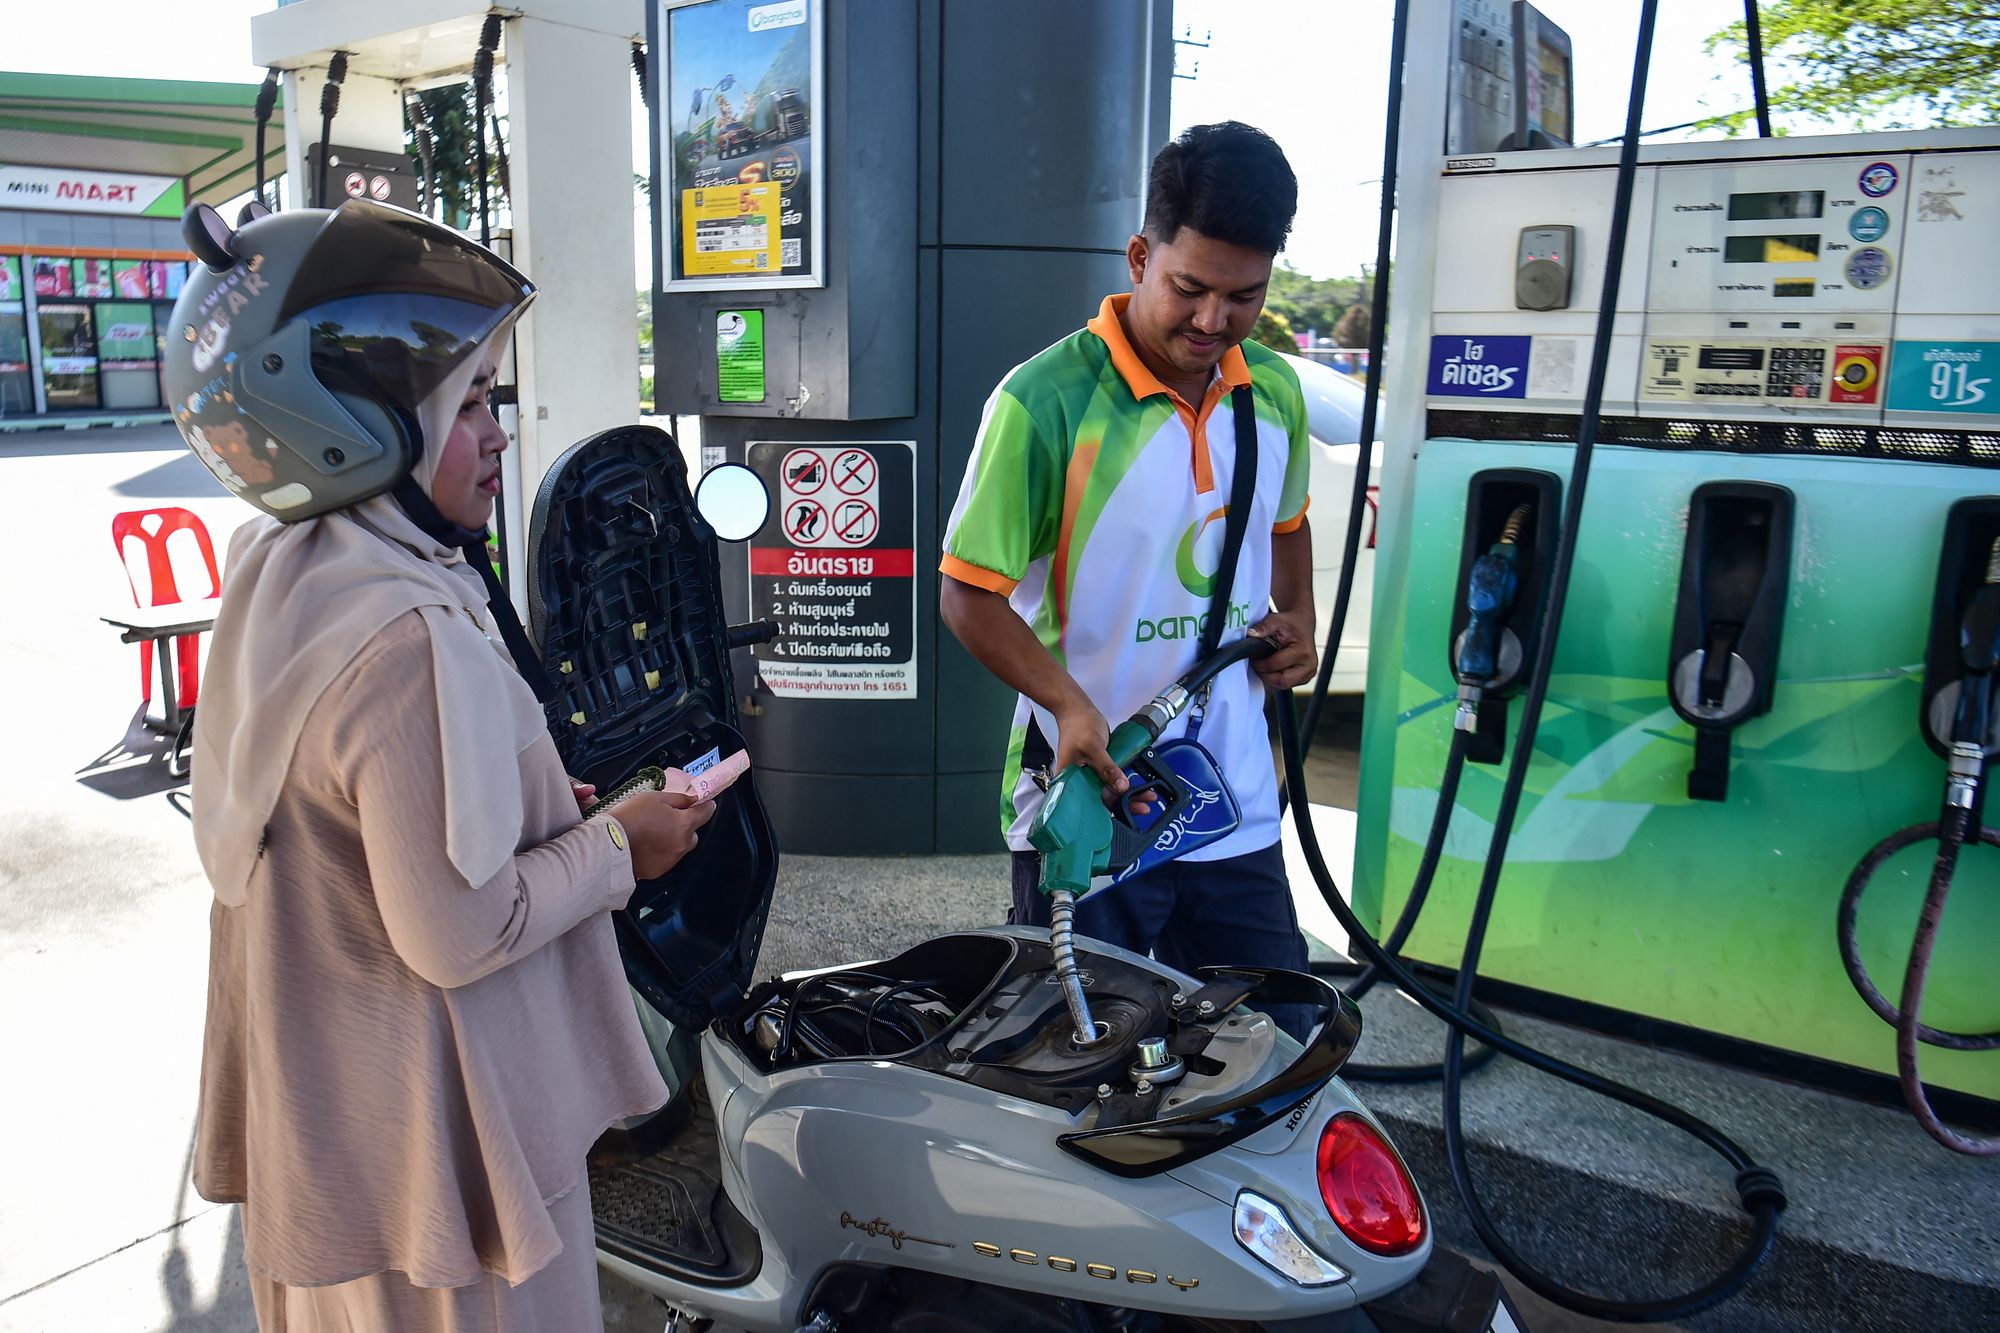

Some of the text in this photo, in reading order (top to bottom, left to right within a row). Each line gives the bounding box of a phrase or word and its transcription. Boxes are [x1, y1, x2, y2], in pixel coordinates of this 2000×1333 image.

[8, 180, 137, 203] MINI MART
[1463, 339, 1485, 361] ไฮ
[788, 551, 873, 575] อันตราย
[773, 578, 872, 596] 1. ดับเครื่องยนต์
[773, 599, 855, 620] 2. ห้ามสูบบุหรี่
[789, 622, 889, 637] ห้ามก่อประกายไฟ
[774, 642, 892, 657] 4. ปิดโทรศัพท์มือถือ
[863, 681, 879, 691] โทร
[883, 681, 908, 692] 1651
